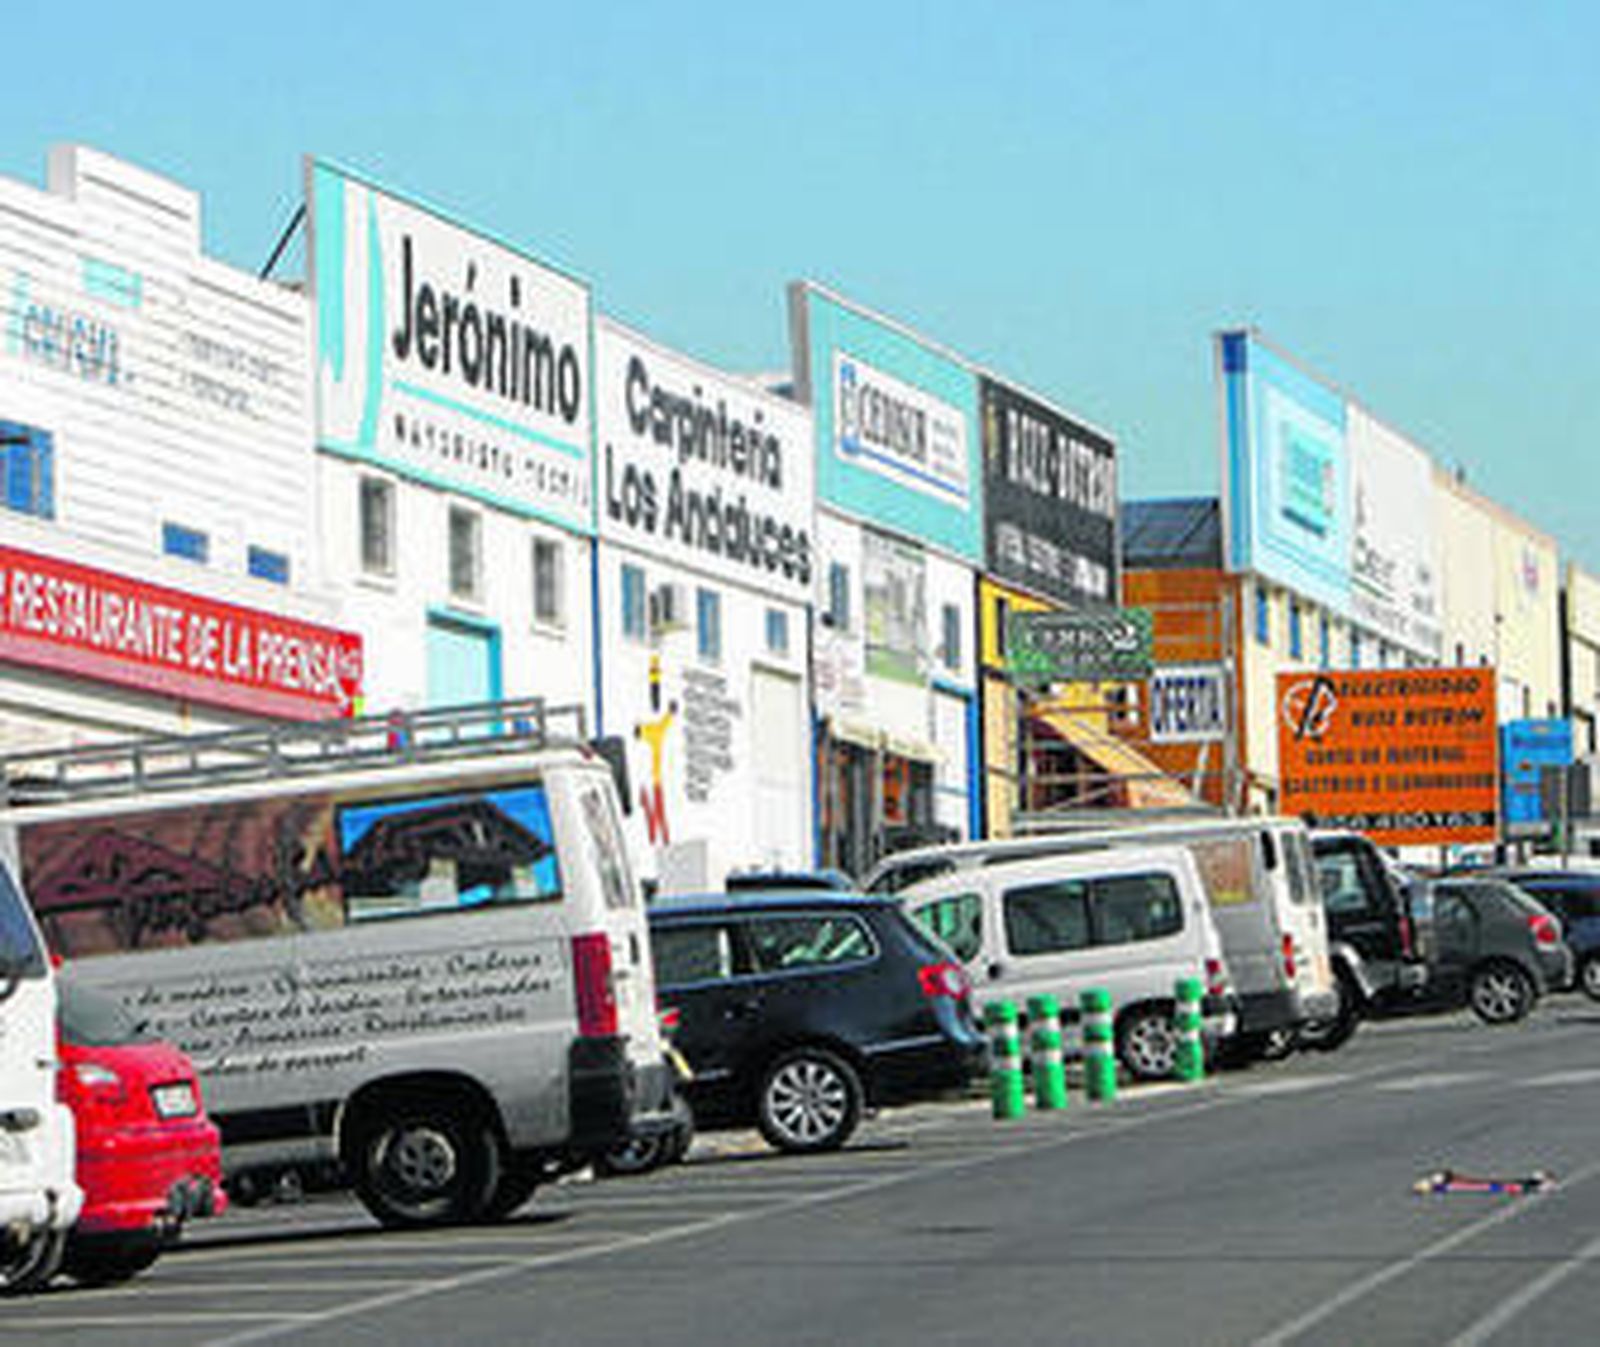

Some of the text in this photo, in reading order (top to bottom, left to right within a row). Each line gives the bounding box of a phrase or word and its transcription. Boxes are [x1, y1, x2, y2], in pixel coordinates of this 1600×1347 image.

[392, 234, 581, 425] Jerónimo
[605, 444, 812, 586] Los Andaluces
[10, 570, 183, 664] RESTAURANTE
[187, 612, 220, 670] DE
[222, 620, 250, 677] LA
[257, 630, 349, 702] PRENSA
